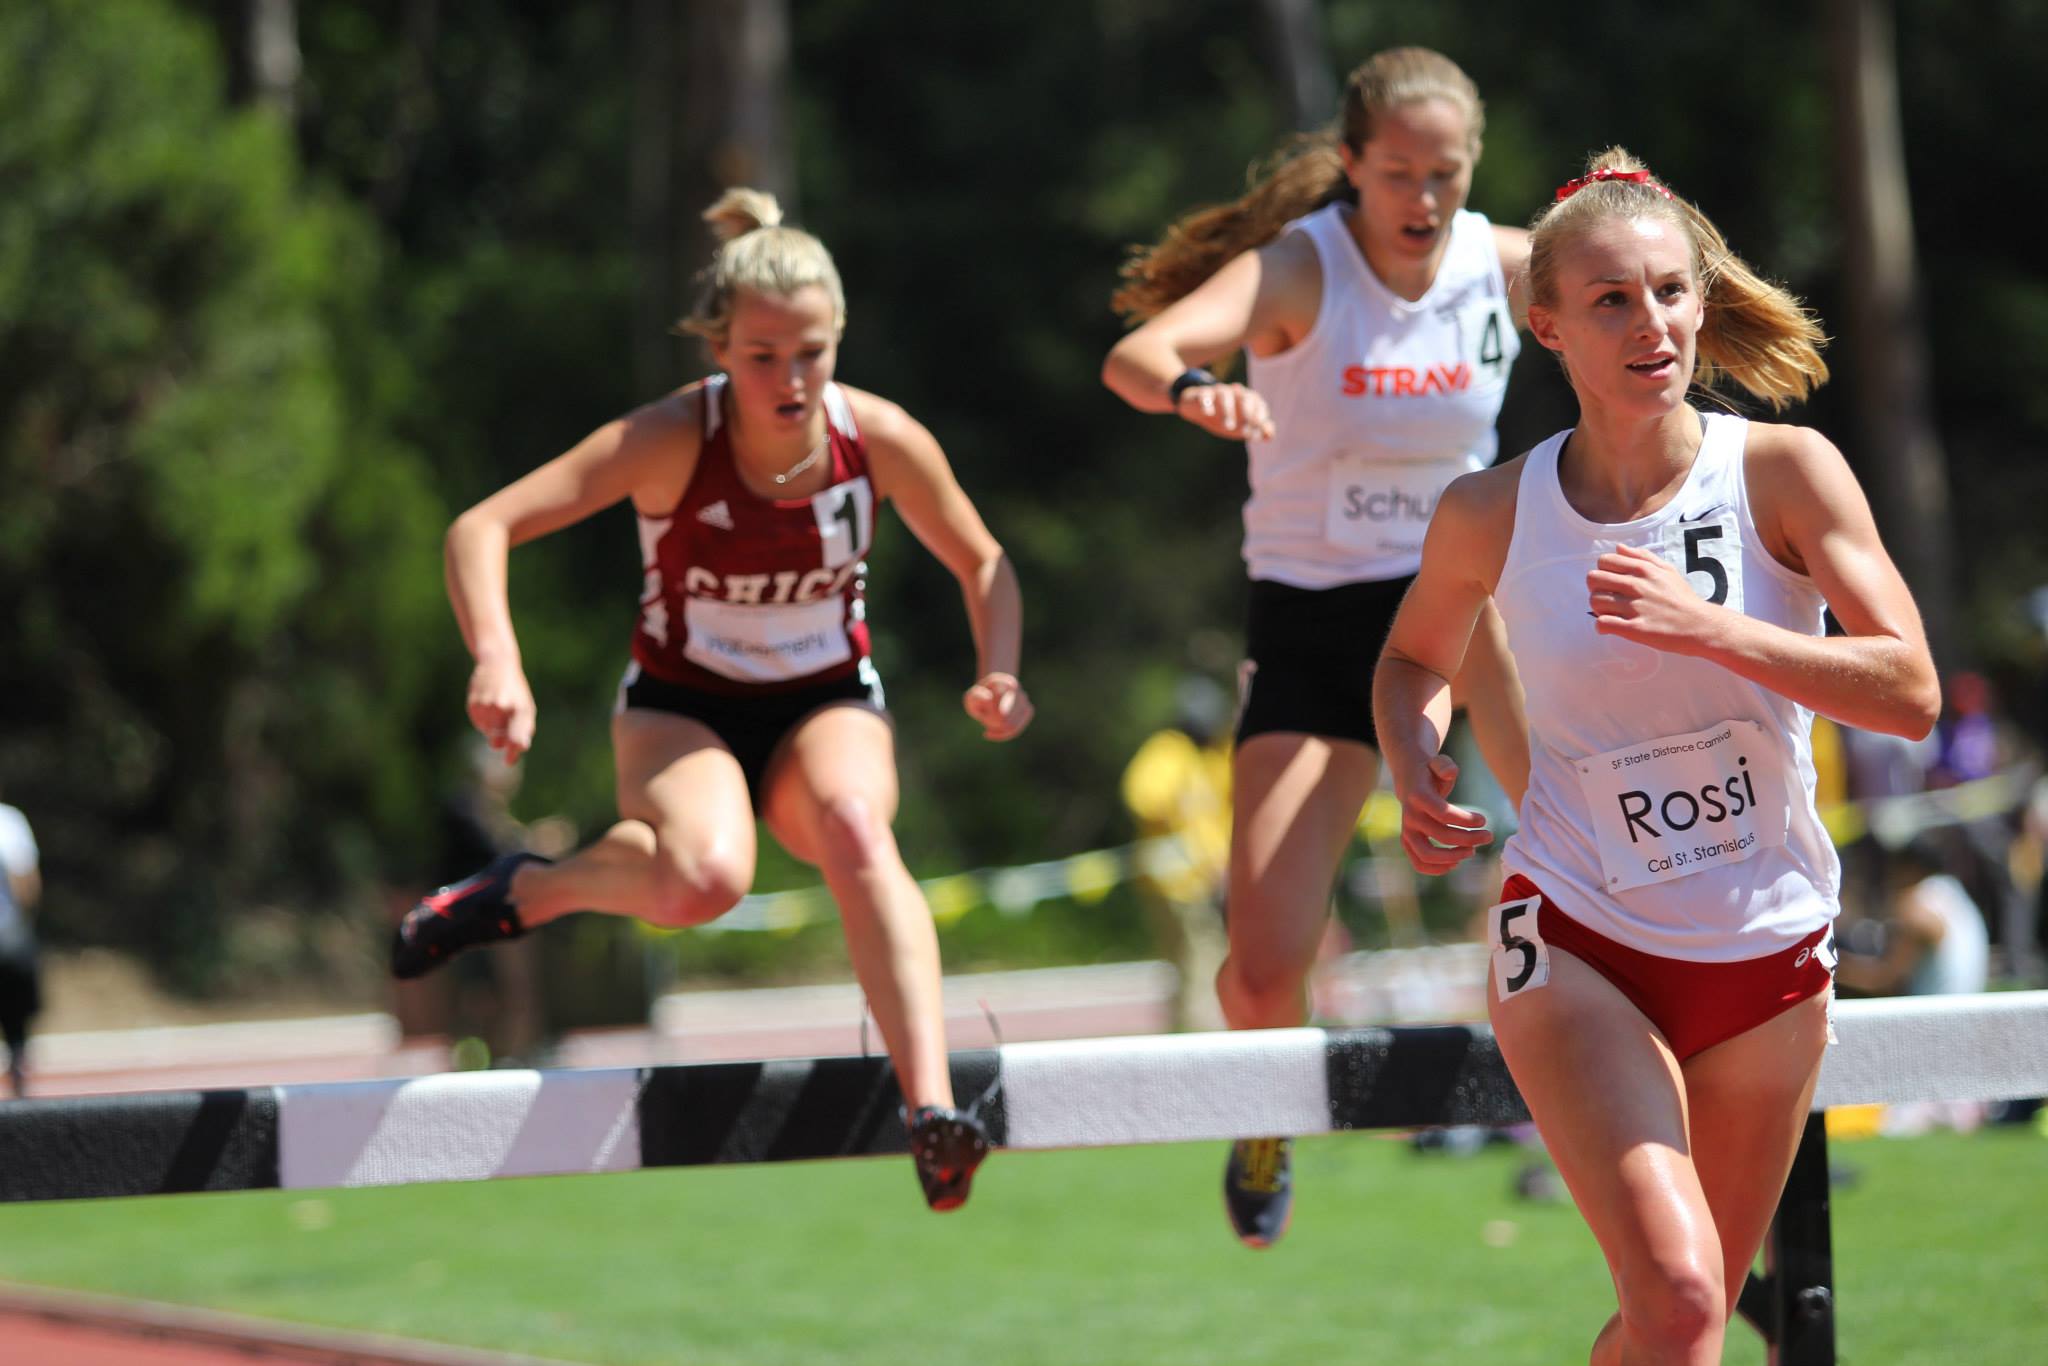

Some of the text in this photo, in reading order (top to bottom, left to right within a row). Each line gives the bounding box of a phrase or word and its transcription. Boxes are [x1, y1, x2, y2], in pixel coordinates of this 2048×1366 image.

[1480, 312, 1502, 377] 4
[834, 493, 859, 555] 1
[1684, 525, 1728, 606] 5
[1611, 730, 1732, 770] SF State Distance Carnival
[1617, 756, 1757, 843] Rossi
[1647, 832, 1755, 873] Cal St. Stanislaus
[1500, 903, 1537, 992] 5
